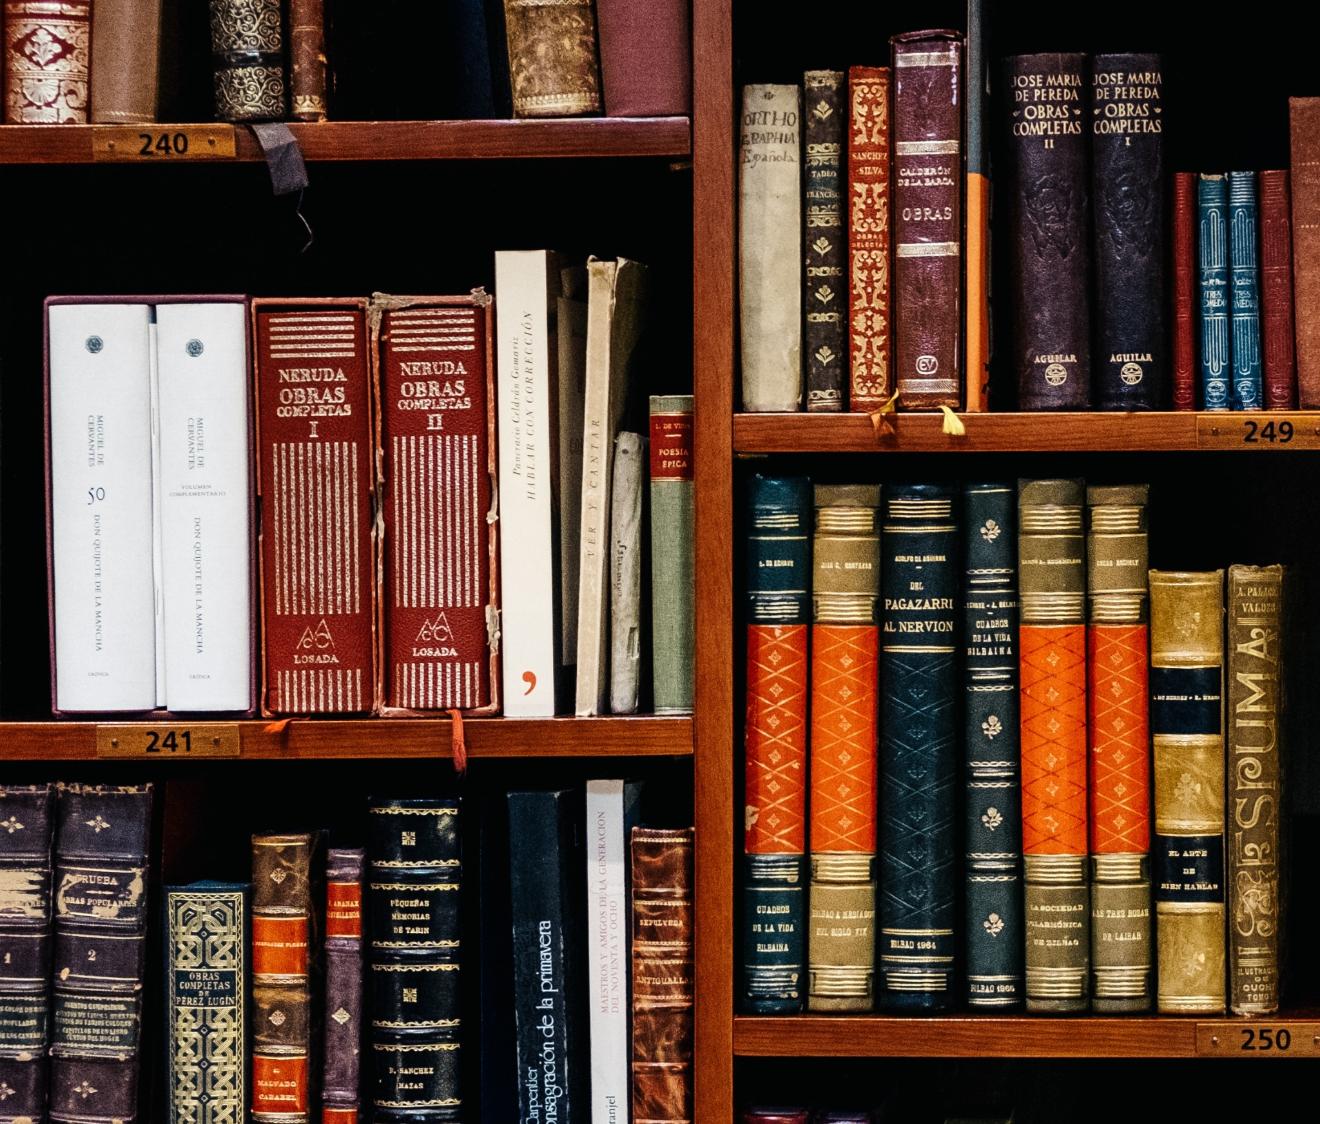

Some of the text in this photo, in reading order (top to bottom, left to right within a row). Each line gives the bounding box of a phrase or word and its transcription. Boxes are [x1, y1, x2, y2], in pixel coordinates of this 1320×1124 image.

[1011, 74, 1082, 88] JOSE MARIA
[1092, 72, 1162, 86] JOSE MARIA
[1015, 89, 1079, 102] DE PEREDA
[1096, 87, 1160, 100] DE PEREDA
[1024, 105, 1069, 120] OBRAS
[1105, 103, 1149, 118] OBRAS
[743, 110, 797, 127] ORTHO
[1013, 121, 1082, 136] COMPLETAS
[1093, 119, 1162, 134] COMPLETAS
[139, 133, 189, 156] 240
[1044, 139, 1054, 149] II
[1125, 137, 1131, 146] I
[851, 151, 888, 161] SANCHEZ
[900, 166, 951, 177] CALDERÓN
[902, 206, 952, 221] OBRAS
[1034, 353, 1078, 364] AGUILAR
[1110, 353, 1153, 363] AGUILAR
[279, 368, 348, 383] NERUDA
[399, 362, 468, 377] NERUDA
[280, 387, 345, 405] OBRAS
[401, 381, 466, 399] OBRAS
[276, 405, 352, 417] COMPLETAS
[397, 399, 472, 411] COMPLETAS
[522, 312, 536, 501] HABLAR CON CORRECCIÓN
[427, 414, 444, 430] II
[309, 421, 319, 438] I
[1244, 421, 1295, 443] 249
[87, 415, 95, 467] CERVANTES
[96, 416, 104, 466] MIGUEL DE
[187, 418, 196, 470] CERVANTES
[196, 418, 204, 468] MIGUEL DE
[87, 487, 105, 505] 50
[93, 540, 101, 578] QUIJOTE
[192, 543, 201, 580] QUIJOTE
[95, 583, 101, 593] DE
[194, 585, 201, 597] DE
[910, 582, 924, 591] DEL
[95, 597, 102, 610] LA
[195, 600, 202, 611] LA
[885, 598, 954, 610] PAGAZARRI
[95, 613, 103, 653] MANCHA
[883, 620, 954, 633] AL NERVION
[195, 614, 203, 655] MANCHA
[294, 655, 340, 664] LOSADA
[413, 648, 458, 658] LOSADA
[146, 731, 191, 752] 241
[390, 898, 430, 907] PEQUEÑAS
[756, 905, 790, 914] CUADROS
[391, 913, 431, 921] MEMORIAS
[752, 923, 795, 932] DE LA VIDA
[4, 952, 12, 964] 1
[88, 949, 97, 961] 2
[535, 920, 559, 993] primavera
[189, 972, 220, 981] OBRAS
[179, 981, 231, 990] COMPLETAS
[535, 997, 554, 1010] la
[536, 1014, 555, 1038] de
[1241, 1029, 1291, 1050] 250
